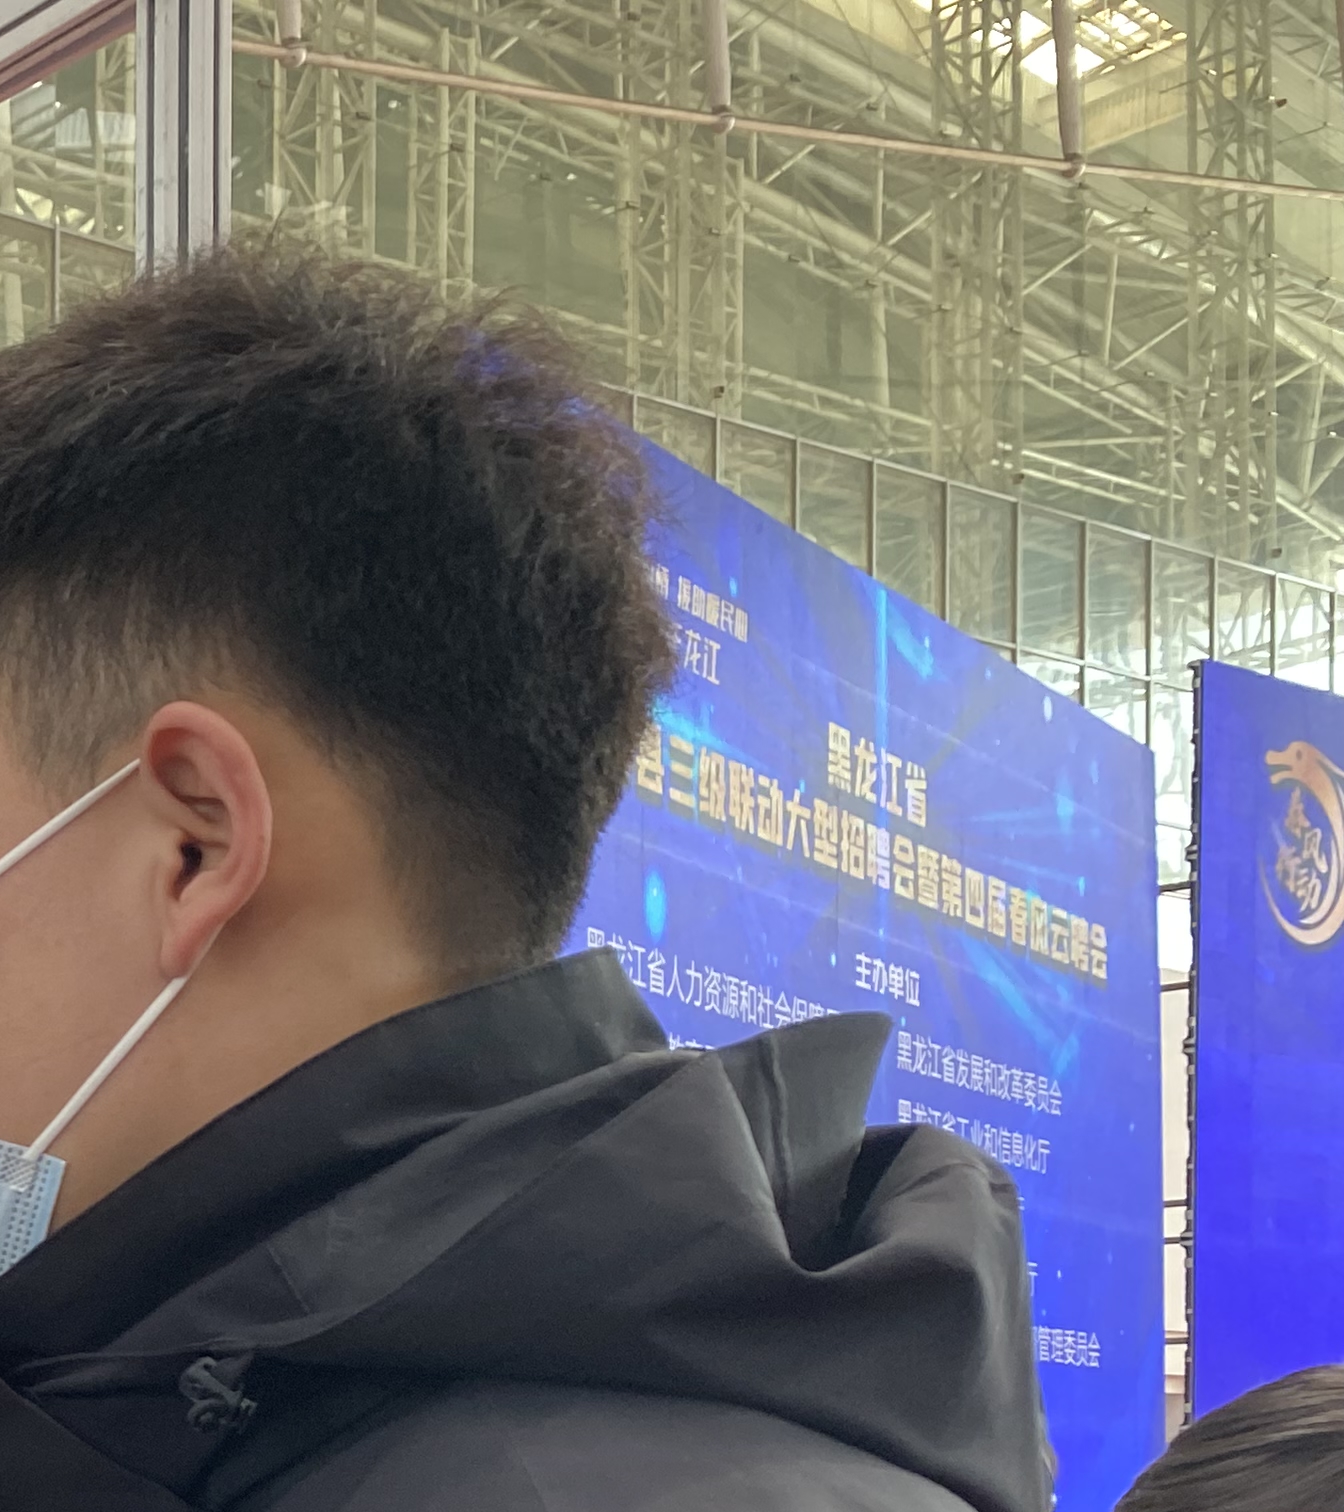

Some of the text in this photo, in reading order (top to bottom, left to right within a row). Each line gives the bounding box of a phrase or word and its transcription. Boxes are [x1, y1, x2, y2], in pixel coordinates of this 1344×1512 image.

[828, 721, 927, 828] 黑龙江省
[855, 952, 920, 1007] 主办单位
[897, 1030, 1062, 1116] 黑龙江省发展和改革委员会
[1032, 1325, 1101, 1368] 管理委员会
